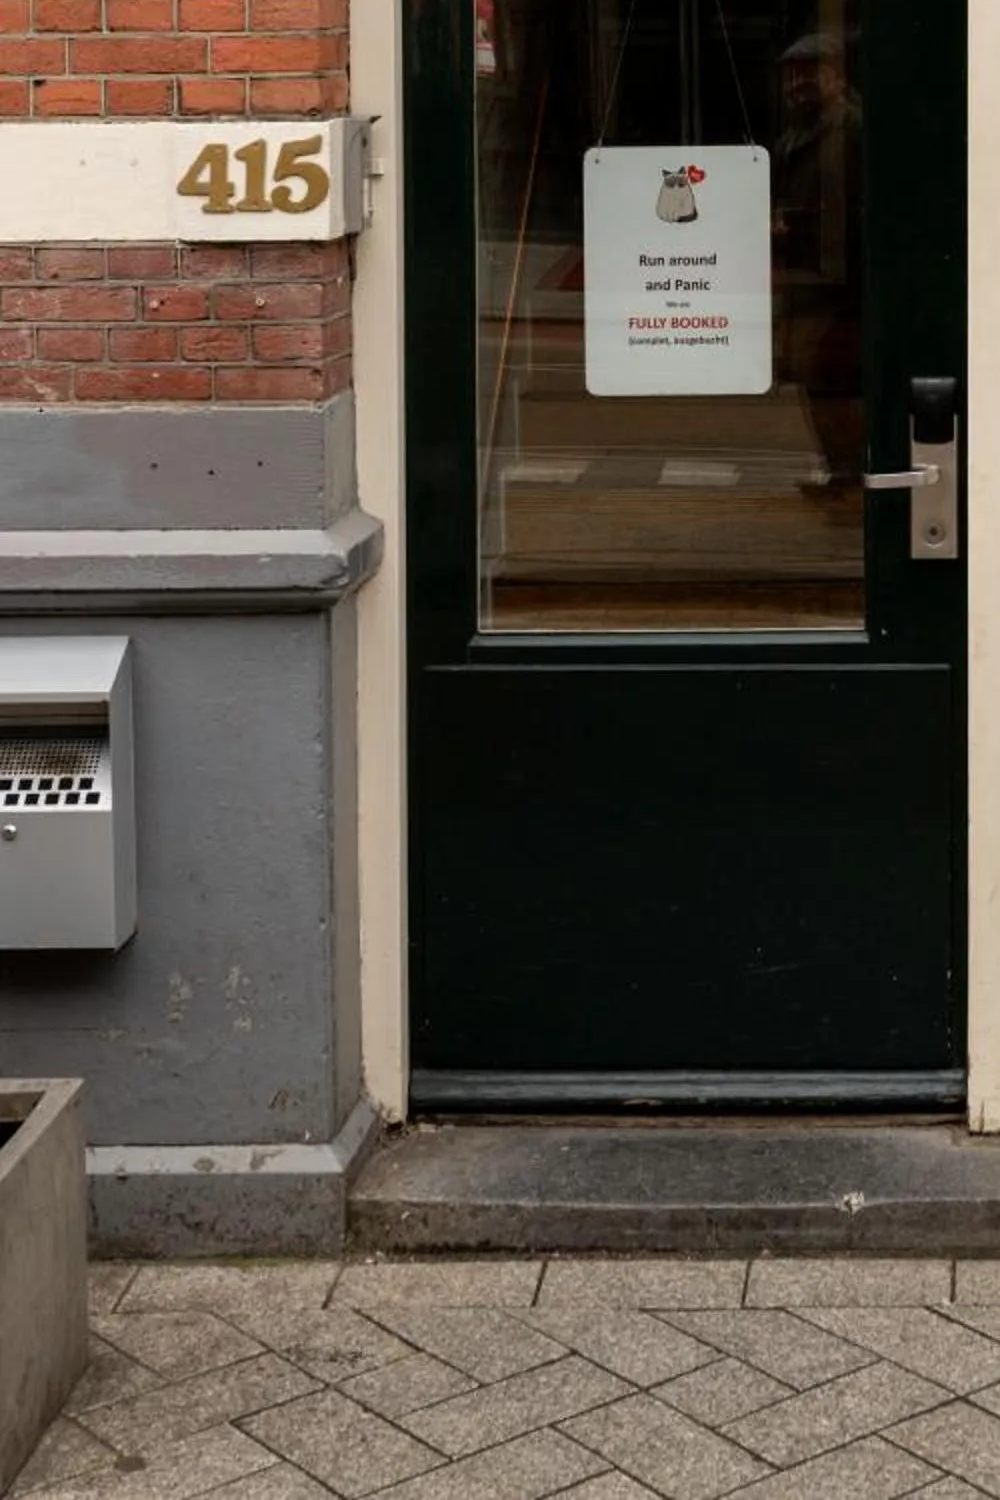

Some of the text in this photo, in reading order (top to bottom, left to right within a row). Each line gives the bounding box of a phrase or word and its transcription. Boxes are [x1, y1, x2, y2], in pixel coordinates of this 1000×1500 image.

[177, 134, 330, 214] 415
[638, 252, 718, 267] Run around
[644, 277, 712, 292] and Panic
[628, 316, 729, 330] FULLY BOOKED
